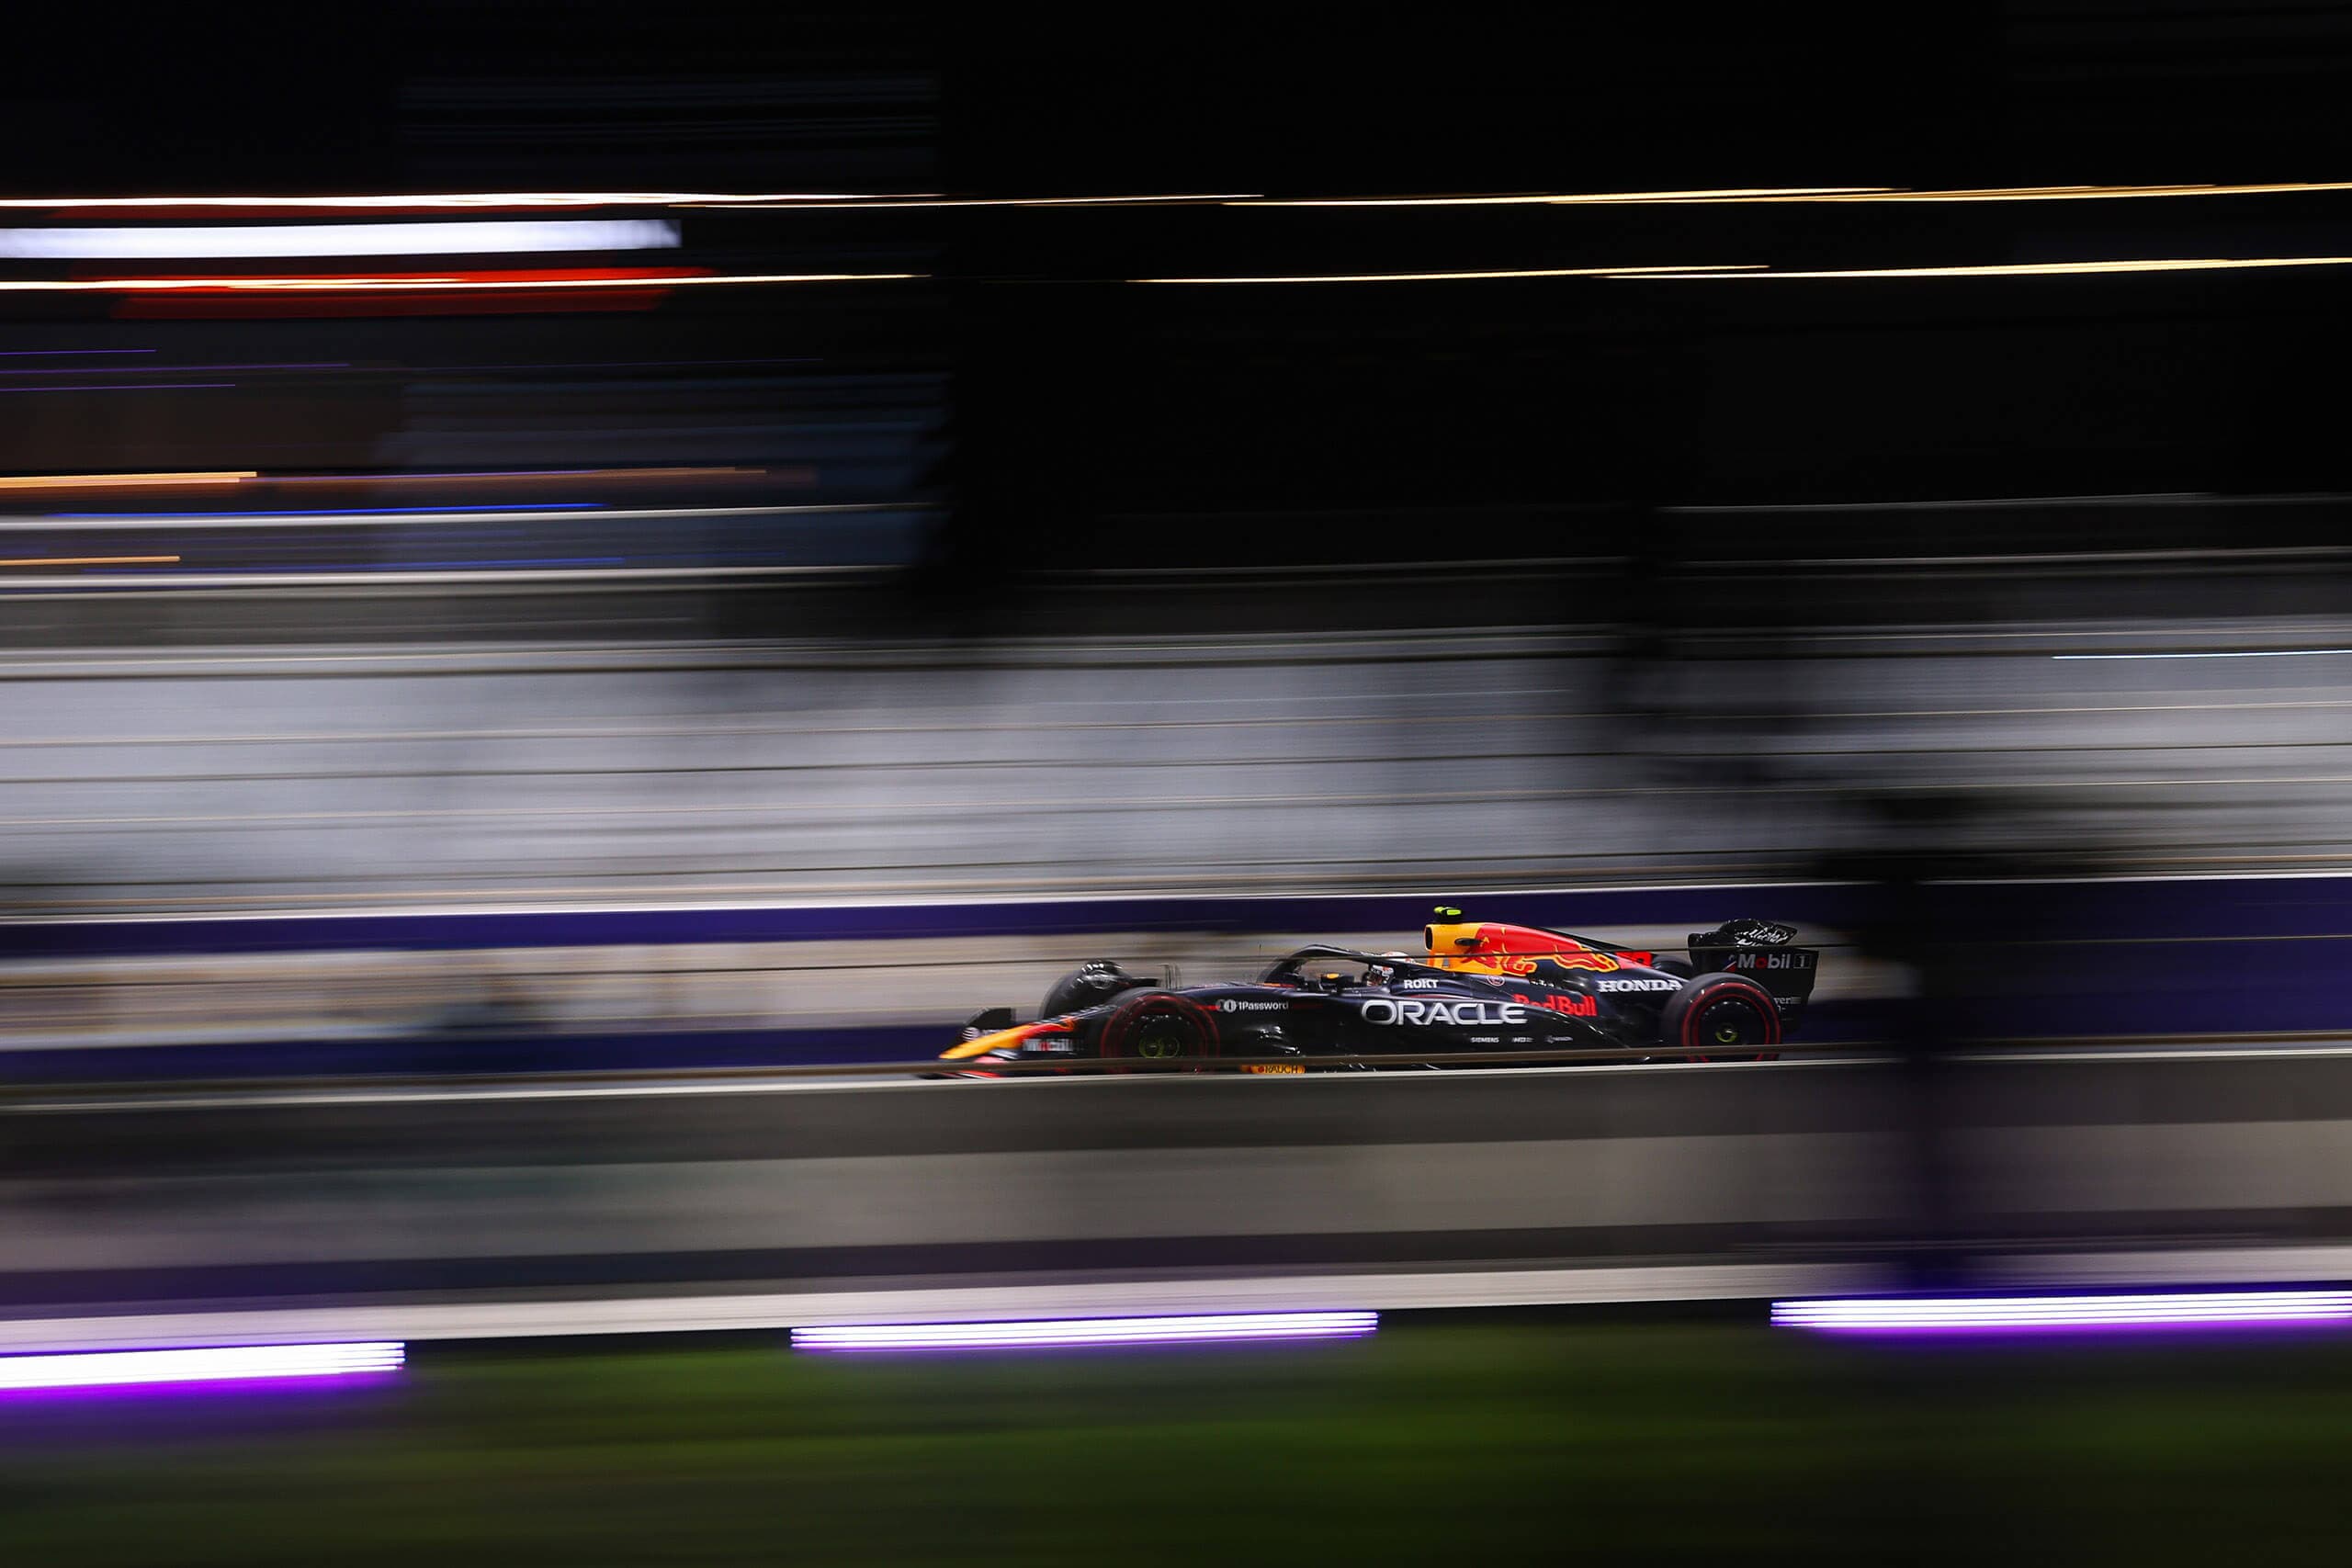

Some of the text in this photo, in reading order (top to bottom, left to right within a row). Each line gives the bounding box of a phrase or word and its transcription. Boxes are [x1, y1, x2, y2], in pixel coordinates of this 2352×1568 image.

[1736, 953, 1792, 969] Mobil
[1404, 978, 1440, 989] ROKT
[1595, 979, 1683, 993] HONDA
[1238, 1000, 1289, 1011] 1Password
[1362, 1000, 1528, 1025] ORACLE
[1556, 995, 1598, 1017] Bull
